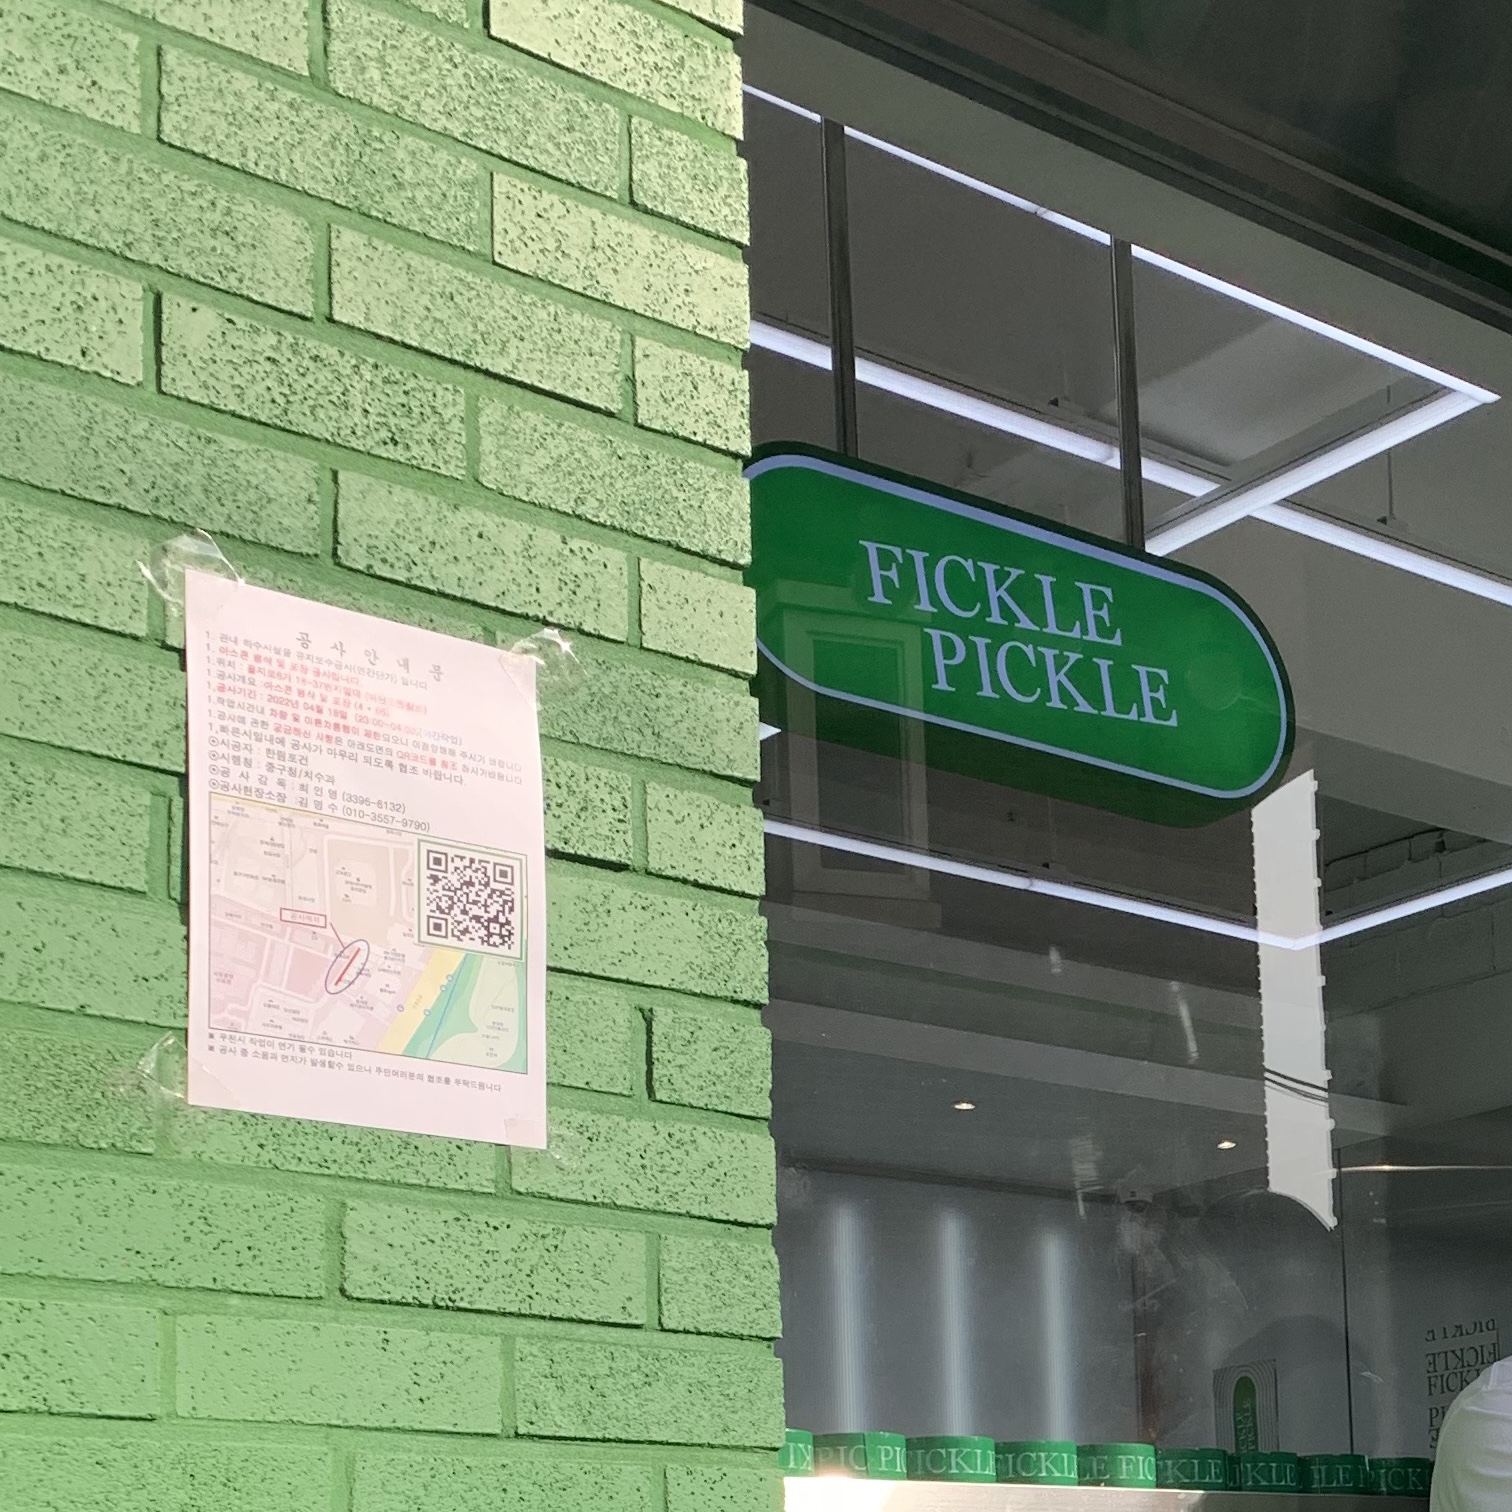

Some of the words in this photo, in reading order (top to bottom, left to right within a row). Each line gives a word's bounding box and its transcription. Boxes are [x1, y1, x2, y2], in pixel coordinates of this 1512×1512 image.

[859, 540, 1122, 645] FICKLE
[924, 628, 1178, 727] PICKLE
[342, 791, 405, 814] (3396-6132)
[342, 805, 430, 833] (010-3557-9790)
